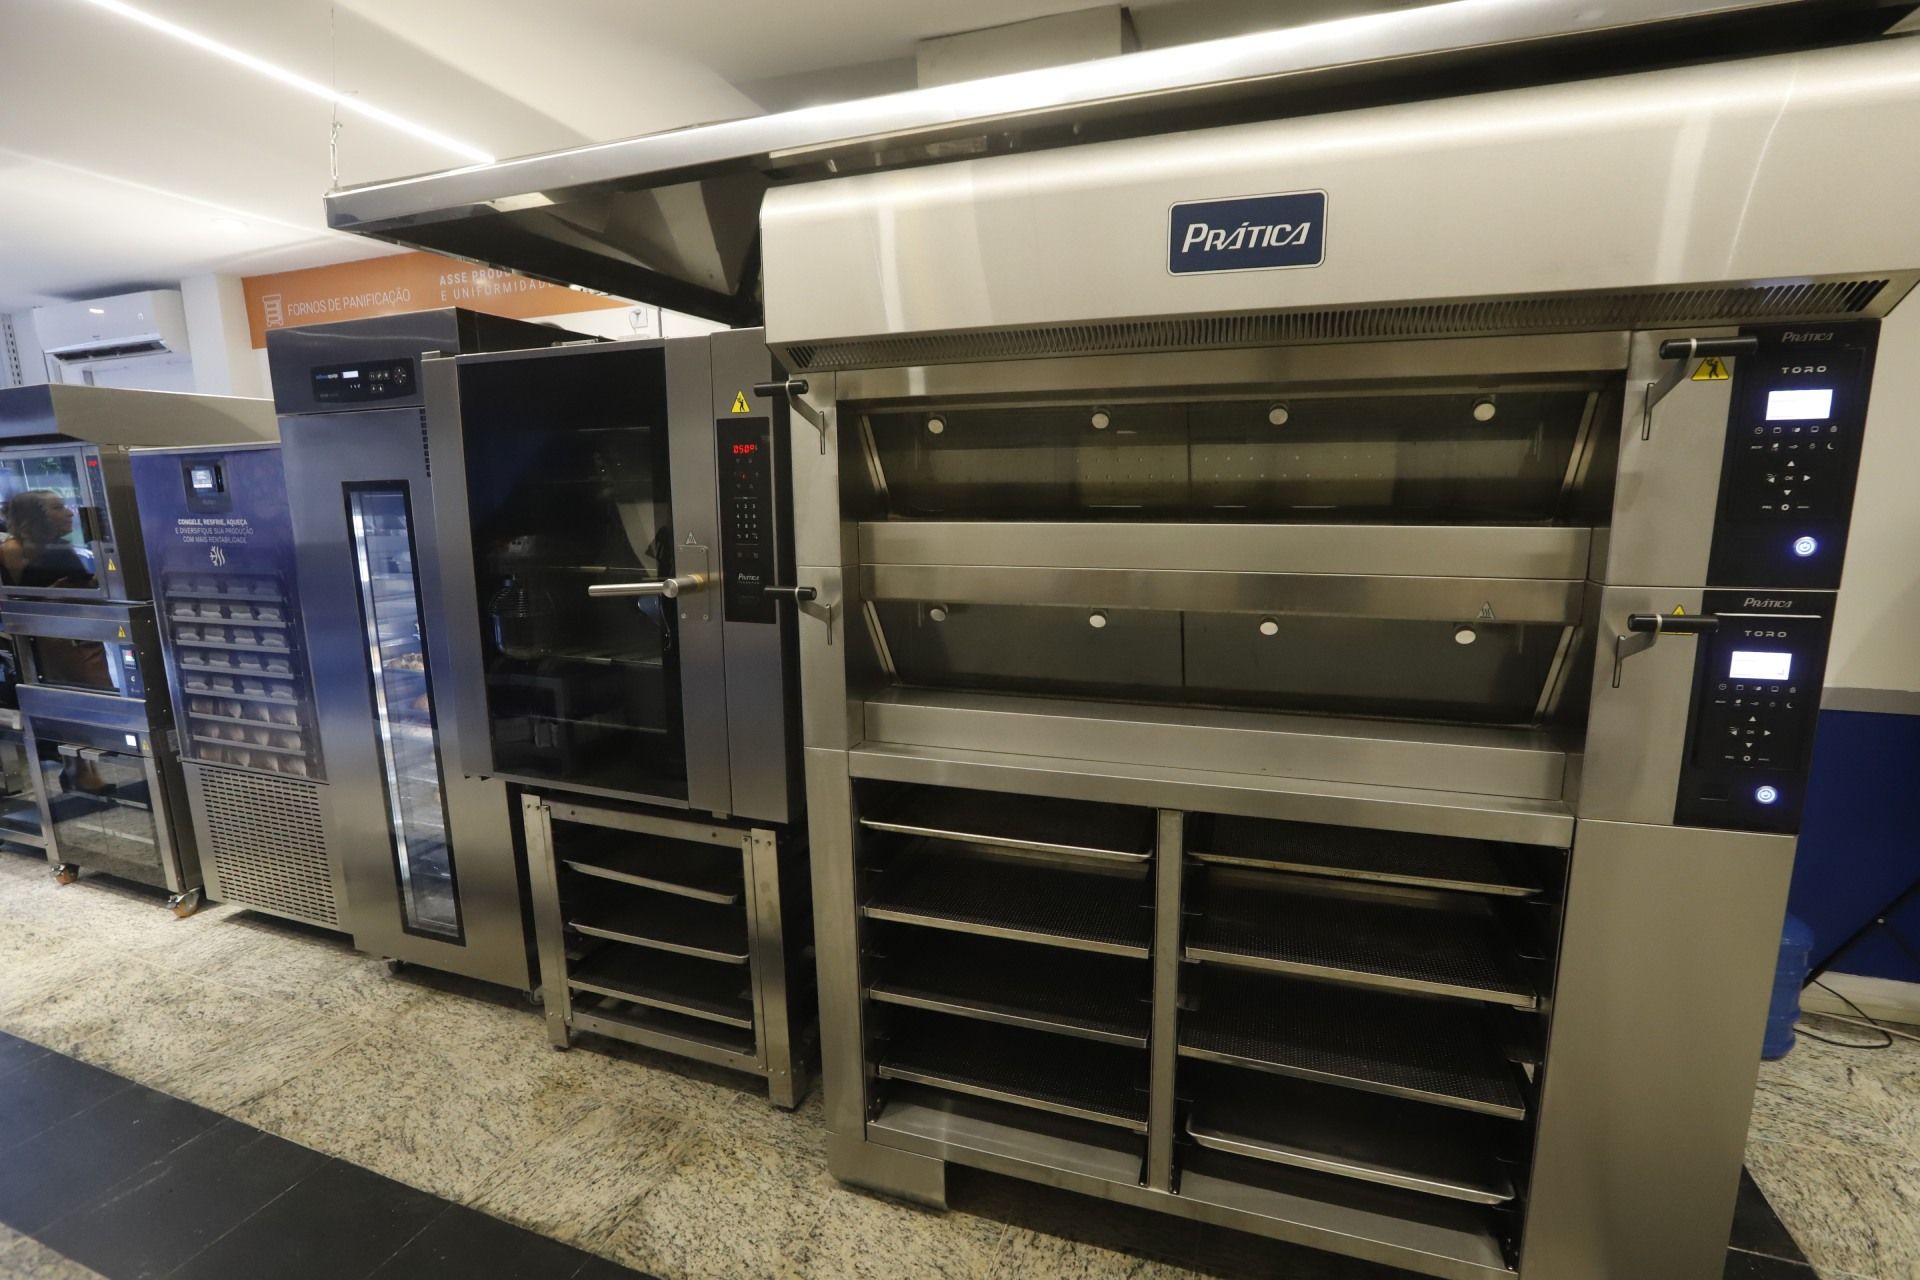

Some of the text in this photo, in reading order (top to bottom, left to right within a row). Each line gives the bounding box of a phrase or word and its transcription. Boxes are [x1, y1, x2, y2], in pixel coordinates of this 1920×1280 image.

[1182, 222, 1311, 253] PRÁTICA
[440, 271, 467, 286] ASSE
[288, 287, 411, 316] FORNOS DE PANIFICAÇÃO
[441, 290, 447, 302] E
[1781, 365, 1827, 375] TORO
[226, 518, 248, 528] AQUEÇA
[1744, 630, 1787, 638] TORO
